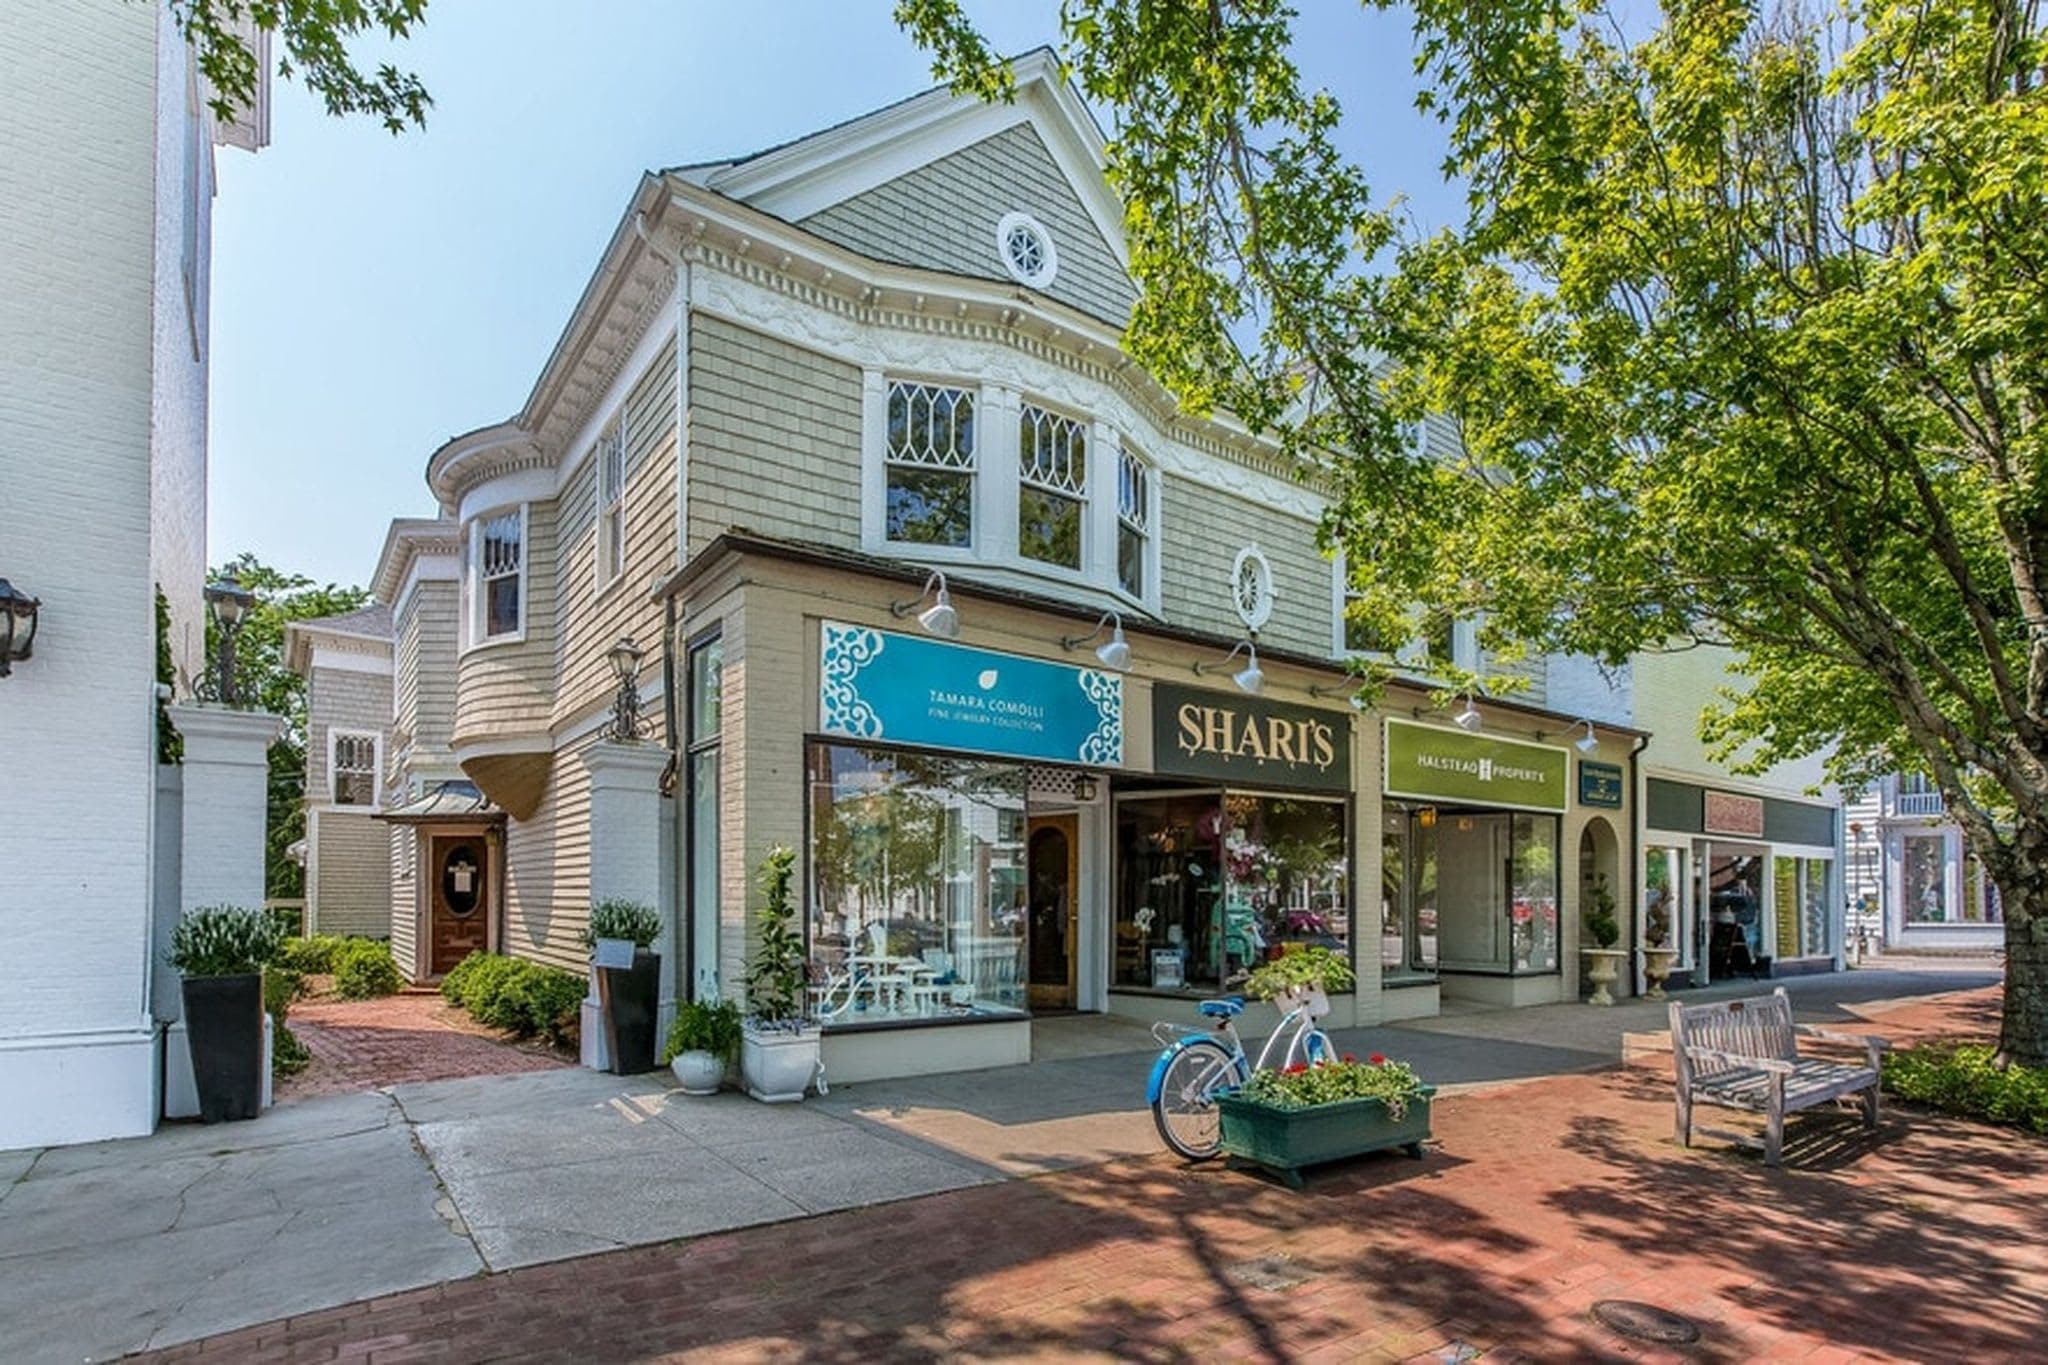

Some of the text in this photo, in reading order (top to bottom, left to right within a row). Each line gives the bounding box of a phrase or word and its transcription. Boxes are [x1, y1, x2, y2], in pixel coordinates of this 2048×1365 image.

[929, 689, 1044, 719] TAMARA COMOLLI
[928, 707, 949, 720] FINE
[993, 716, 1043, 732] COLLECTION
[1178, 703, 1335, 773] SHARI'S
[1417, 754, 1478, 775] HALSTEAD
